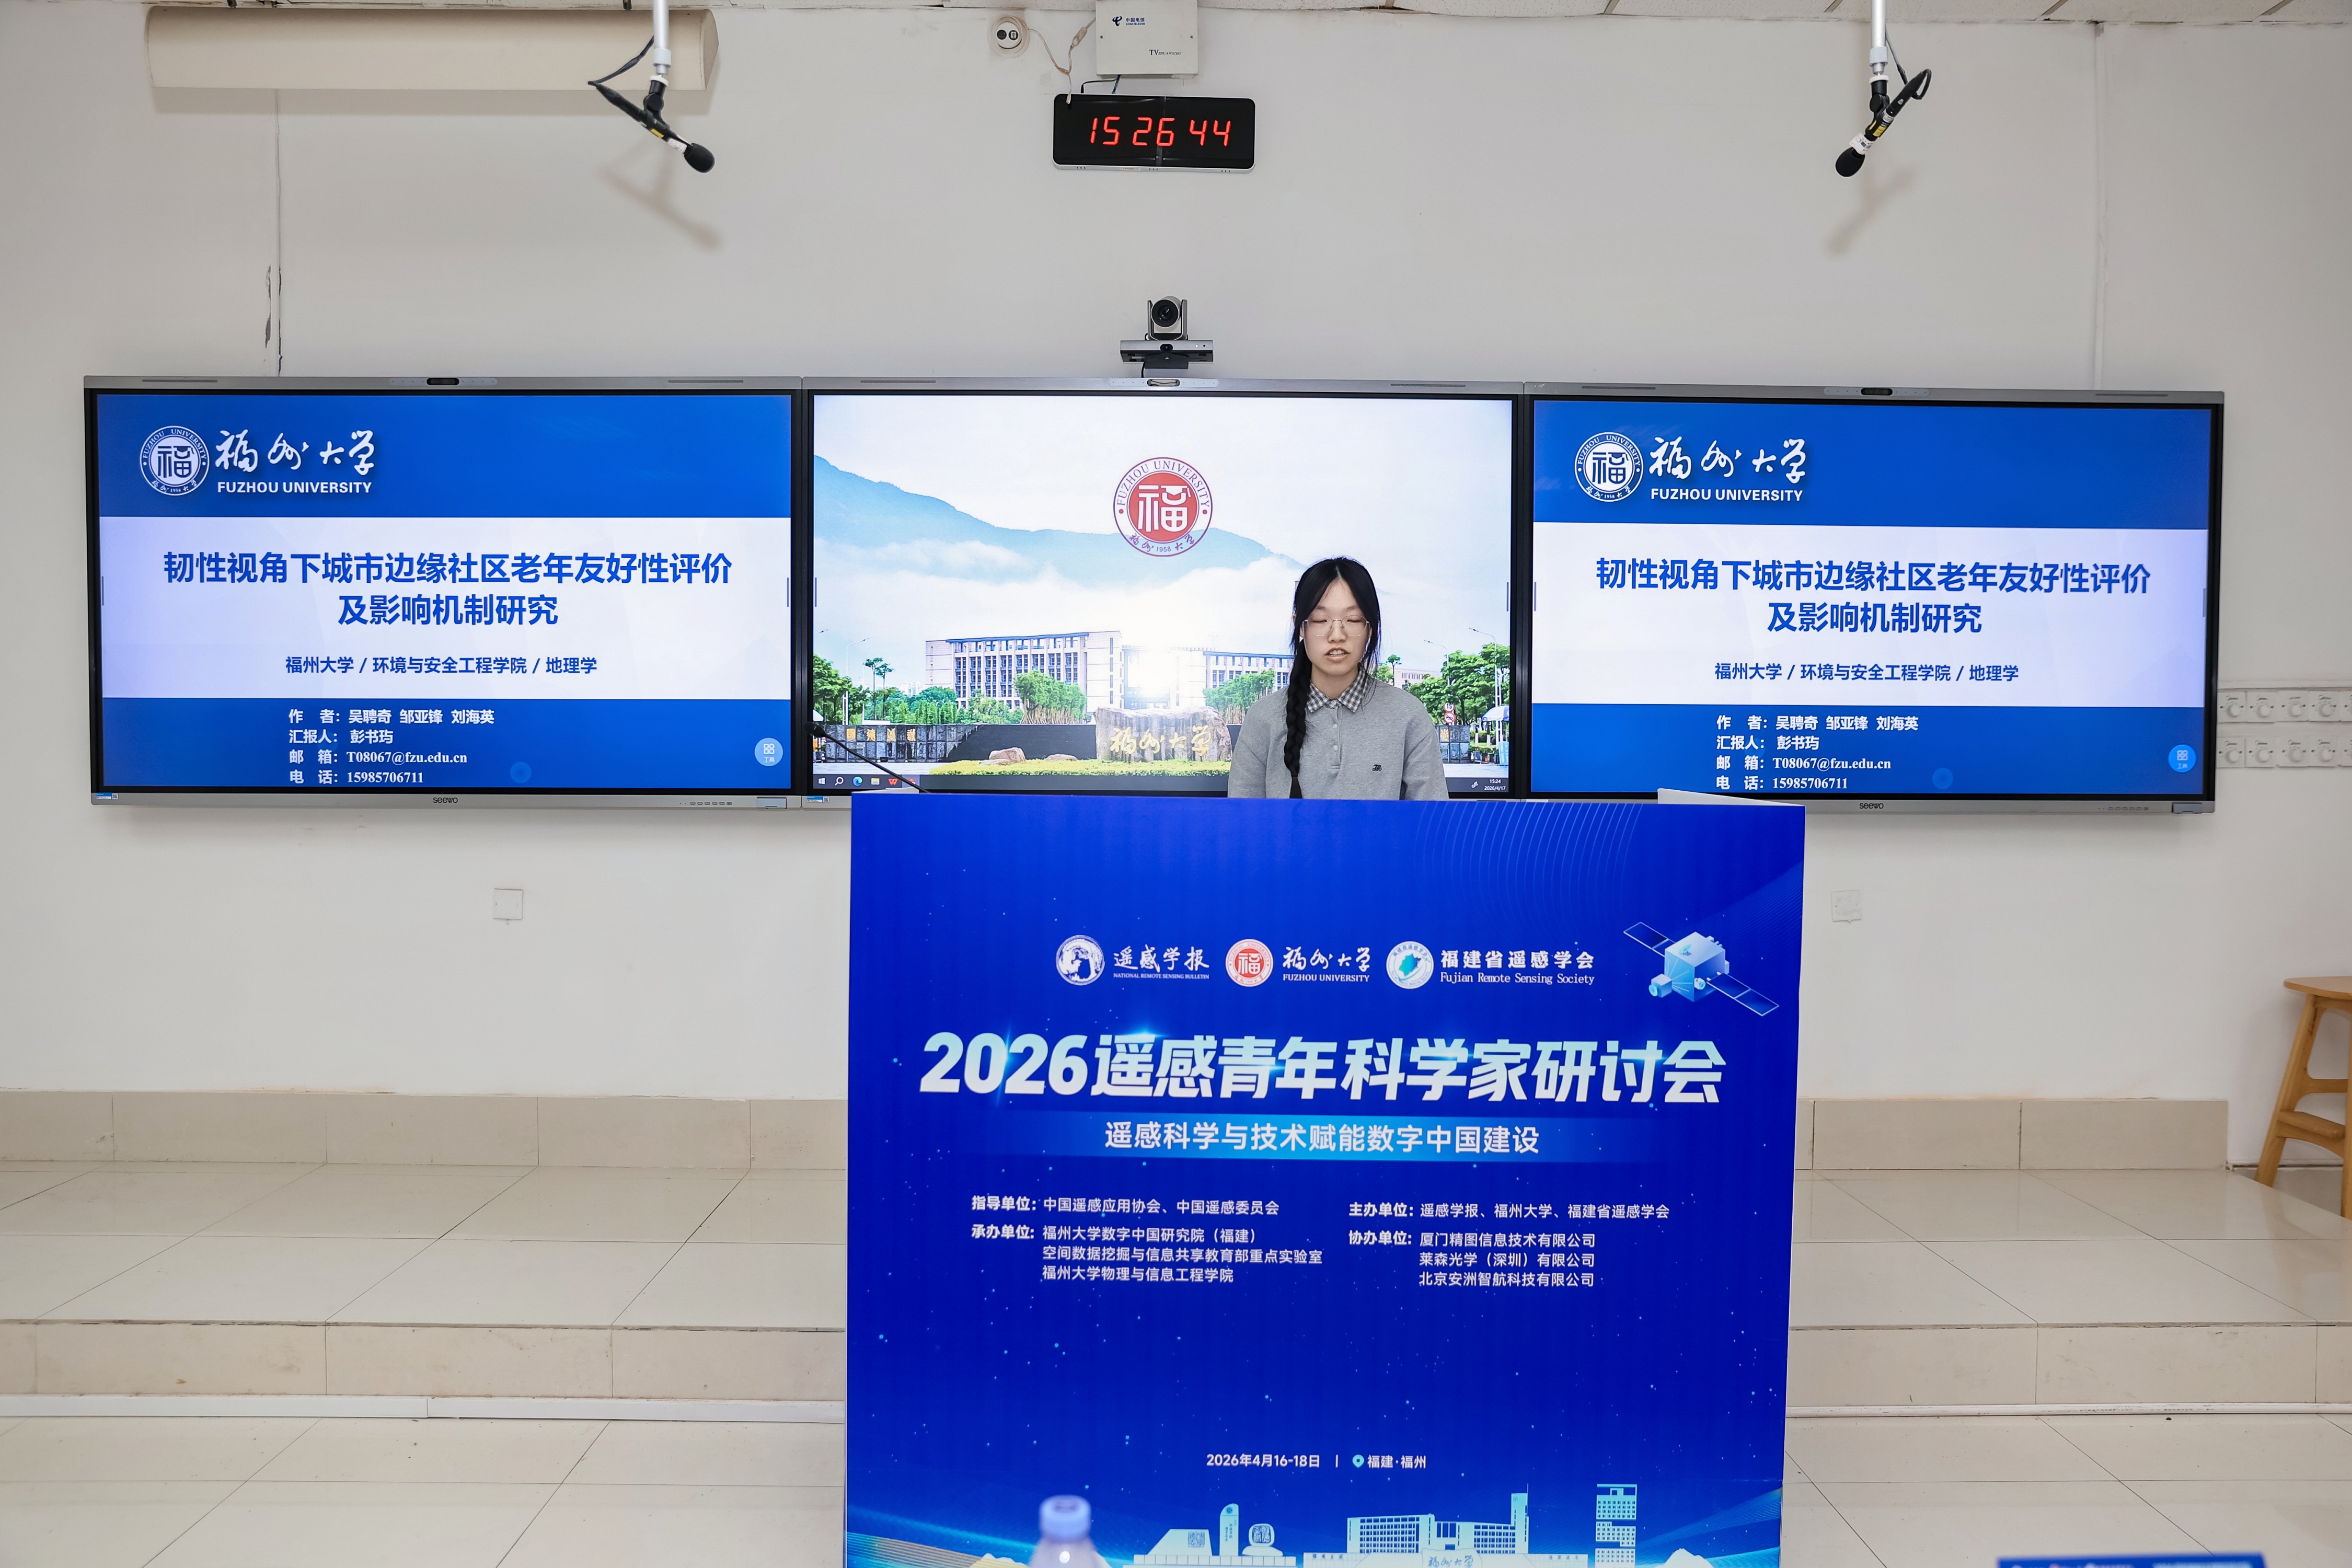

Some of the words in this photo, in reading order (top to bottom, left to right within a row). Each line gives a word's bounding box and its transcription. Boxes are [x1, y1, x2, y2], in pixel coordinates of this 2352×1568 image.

[1091, 117, 1120, 145] 15
[1133, 117, 1174, 146] 26
[1190, 120, 1230, 146] 44
[143, 431, 165, 458] FUZHOU
[171, 429, 206, 459] UNIVERSITY
[215, 430, 374, 475] 福州大学
[1578, 437, 1600, 465] FUZHOU
[1606, 435, 1641, 466] UNIVERSITY
[1649, 436, 1805, 483] 福州大学
[218, 482, 278, 492] FUZHOU
[283, 482, 372, 493] UNIVERSITY
[1117, 464, 1149, 505] FUZHOU
[1154, 460, 1209, 507] UNIVERSITY
[1652, 489, 1711, 500] FUZHOU
[1716, 489, 1803, 501] UNIVERSITY
[164, 552, 732, 583] 韧性视角下城市边缘社区老年友好性评价
[1597, 558, 2151, 593] 韧性视角下城市边缘社区老年友好性评价
[338, 594, 558, 625] 及影响机制研究
[1768, 602, 1981, 633] 及影响机制研究
[286, 656, 354, 673] 福州大学
[373, 656, 527, 674] 环境与安全工程学院
[546, 657, 597, 674] 地理学
[1715, 663, 1782, 679] 福州大学
[1801, 663, 1951, 681] 环境与安全工程学院
[1969, 665, 2018, 681] 地理学
[289, 709, 303, 723] 作
[349, 709, 391, 723] 吴聘奇
[400, 709, 443, 724] 邹亚锋
[451, 709, 494, 724] 刘海英
[1717, 715, 1731, 730] 作
[1776, 716, 1818, 730] 吴聘奇
[1826, 716, 1868, 730] 邹亚锋
[1876, 716, 1918, 730] 刘海英
[289, 729, 337, 743] 汇报人：
[1717, 735, 1764, 750] 汇报人：
[290, 750, 304, 764] 邮
[347, 752, 467, 765] T08067@fzu.edu.cn
[1717, 755, 1730, 770] 邮
[1773, 758, 1890, 771] T08067@fzu.edu.cn
[290, 769, 304, 783] 电
[348, 772, 423, 782] 15985706711
[1716, 776, 1730, 789] 电
[1773, 778, 1847, 789] 15985706711
[1114, 944, 1209, 972] 遥感学报
[1283, 947, 1370, 972] 福州大学
[1441, 949, 1594, 969] 福建省遥感学会
[1441, 972, 1473, 984] Fujian
[1478, 973, 1510, 983] Remote
[1515, 973, 1552, 985] Sensing
[1558, 973, 1594, 985] Society
[919, 1031, 1727, 1104] 2026遥感青年科学家研讨会
[1104, 1121, 1541, 1156] 遥感科学与技术赋能数字中国建设
[972, 1196, 1036, 1211] 指导单位：
[1043, 1197, 1279, 1216] 中国遥感应用协会、中国遥感委员会
[1349, 1202, 1413, 1217] 主办单位：
[1421, 1203, 1669, 1218] 遥感学报、福州大学、福建省遥感学会
[972, 1224, 1034, 1239] 承办单位：
[1043, 1225, 1254, 1243] 福州大学数字中国研究院（福建）
[1349, 1230, 1411, 1245] 协办单位：
[1420, 1232, 1595, 1247] 厦门精图信息技术有限公司
[1043, 1246, 1322, 1265] 空间数据挖掘与信息共享教育部重点实验室
[1420, 1252, 1594, 1267] 莱森光学（深圳）有限公司
[1042, 1265, 1233, 1283] 福州大学物理与信息工程学院
[1419, 1272, 1593, 1286] 北京安洲智航科技有限公司
[1207, 1454, 1319, 1467] 2026年4月16-18日
[1368, 1455, 1426, 1468] 福建·福州
